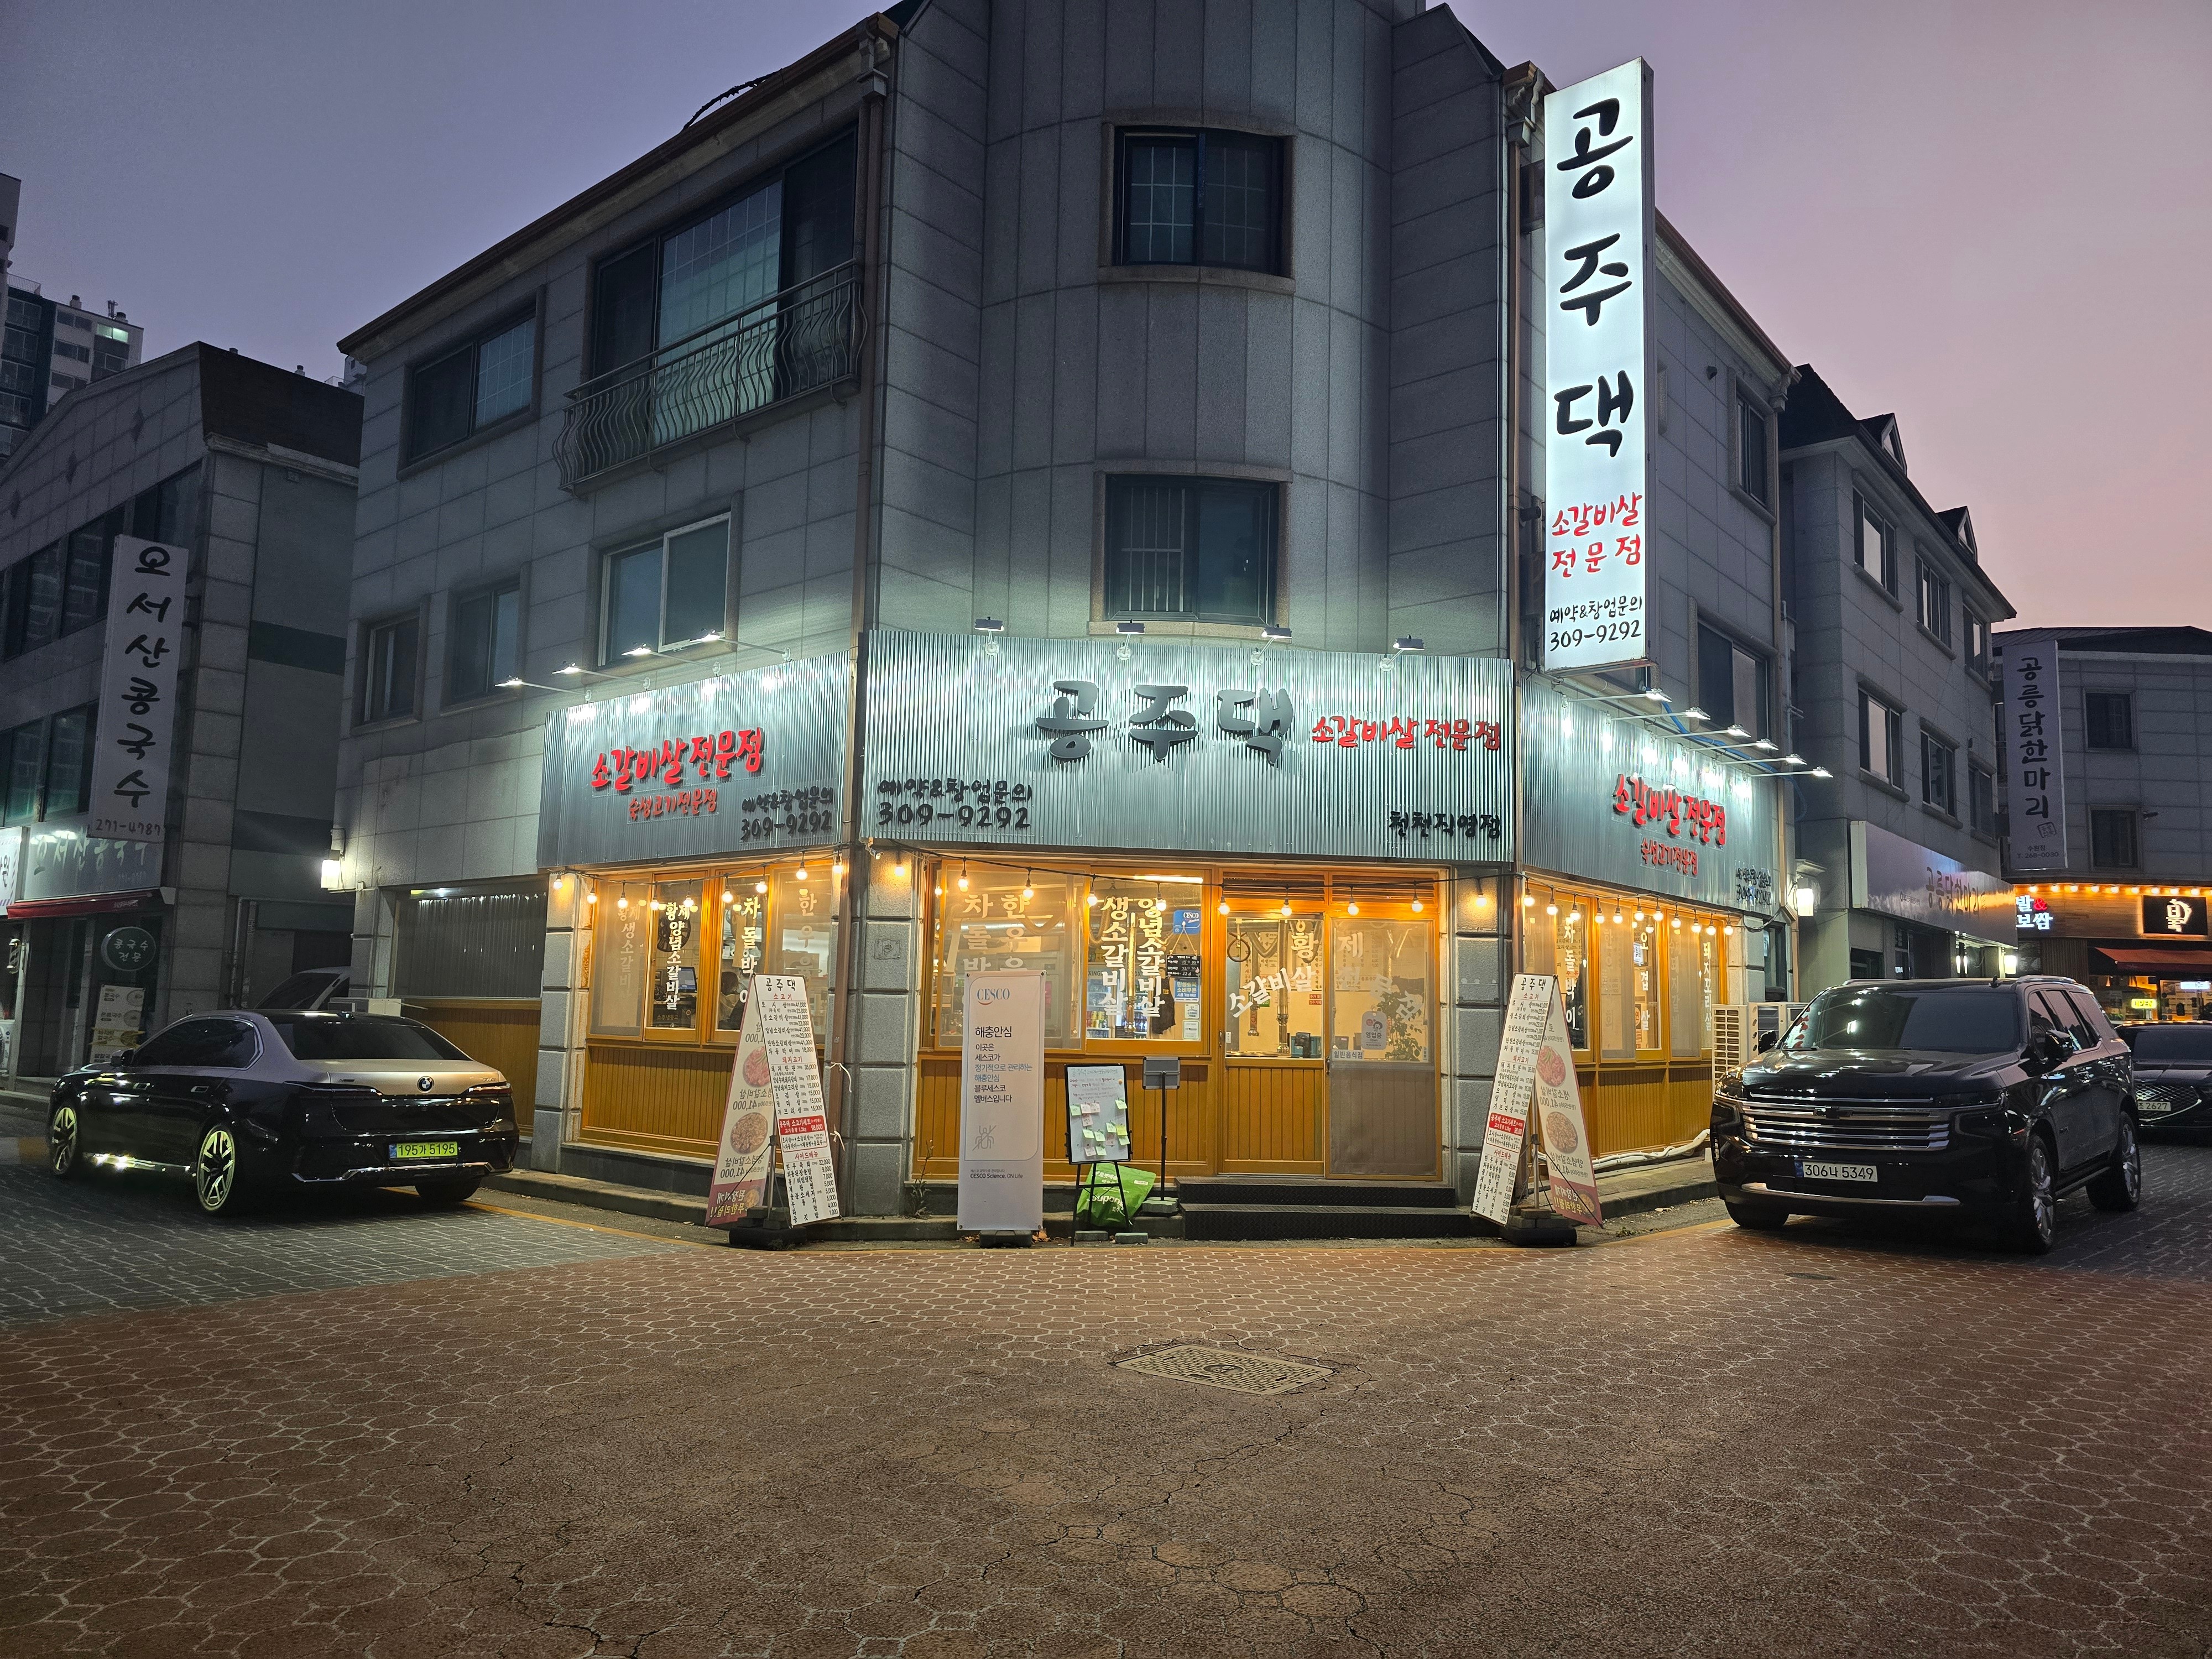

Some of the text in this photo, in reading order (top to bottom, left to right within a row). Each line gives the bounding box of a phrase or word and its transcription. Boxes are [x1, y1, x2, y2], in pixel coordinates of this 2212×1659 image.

[1554, 98, 1634, 458] 공주댁
[1552, 492, 1642, 536] 소갈비살
[1552, 534, 1641, 577] 전문점
[1550, 596, 1642, 624] 예약&창업문의
[1550, 619, 1642, 652] 309-9292
[113, 546, 171, 807] 오서산콩국수
[1036, 680, 1293, 766] 공주댁
[1312, 716, 1500, 750] 소갈비살 전문점
[2017, 656, 2051, 818] 공릉닭한마리
[591, 727, 765, 791] 소갈비살 전문점
[742, 786, 833, 813] 예약&창업문의
[878, 778, 1032, 804] 예약&창업문의
[879, 803, 1030, 828] 309-9292
[1613, 774, 1725, 845] 소갈비살 전문점
[740, 810, 832, 840] 309-9292
[665, 902, 690, 921] 황제
[2016, 912, 2053, 930] 보쌈
[119, 952, 142, 962] 전문
[665, 921, 686, 1010] 양념소갈비살
[1099, 896, 1129, 1018] 생소갈비살
[1137, 898, 1165, 1017] 양념소갈비살
[764, 978, 796, 992] 공주댁
[1520, 977, 1546, 992] 공주댁
[1563, 918, 1579, 1030] 차돌박이
[1640, 932, 1650, 1031] 오겹살
[1703, 942, 1712, 1031] 돼지꼬리살
[977, 988, 1010, 1000] CESCO
[1229, 966, 1317, 1018] 소갈비살
[975, 1026, 1012, 1038] 해충안심
[974, 1063, 1032, 1072] 정기적으로 관리하는
[975, 1053, 1000, 1062] 세스코가
[1512, 1055, 1528, 1063] 돼지고기
[974, 1074, 1000, 1082] 해충안심
[974, 1084, 1006, 1093] 블루세스코
[974, 1094, 1013, 1103] 멤버스입니다
[398, 1144, 455, 1156] 195가 5195
[794, 1150, 818, 1160] 사이드메뉴
[1842, 1166, 1874, 1180] 5349
